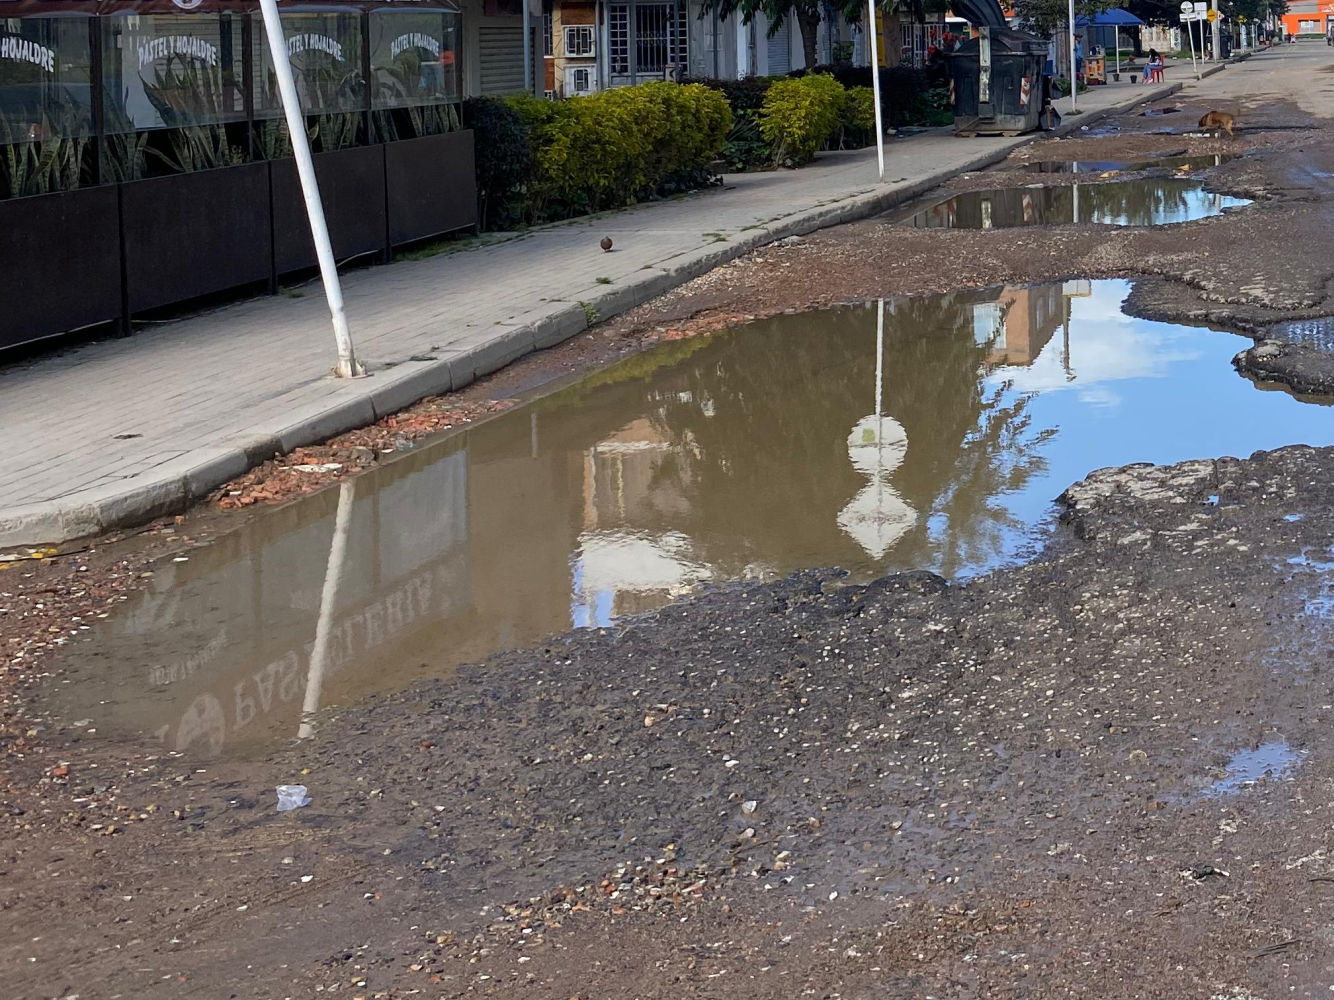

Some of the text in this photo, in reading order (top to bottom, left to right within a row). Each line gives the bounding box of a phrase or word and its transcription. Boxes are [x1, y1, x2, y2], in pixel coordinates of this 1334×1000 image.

[1, 37, 54, 72] HOJALDRE
[138, 35, 217, 70] PASTEL Y HOJALDRE
[285, 35, 304, 57] STEL
[309, 33, 343, 62] HOJALDRE
[391, 34, 408, 61] PASTEL
